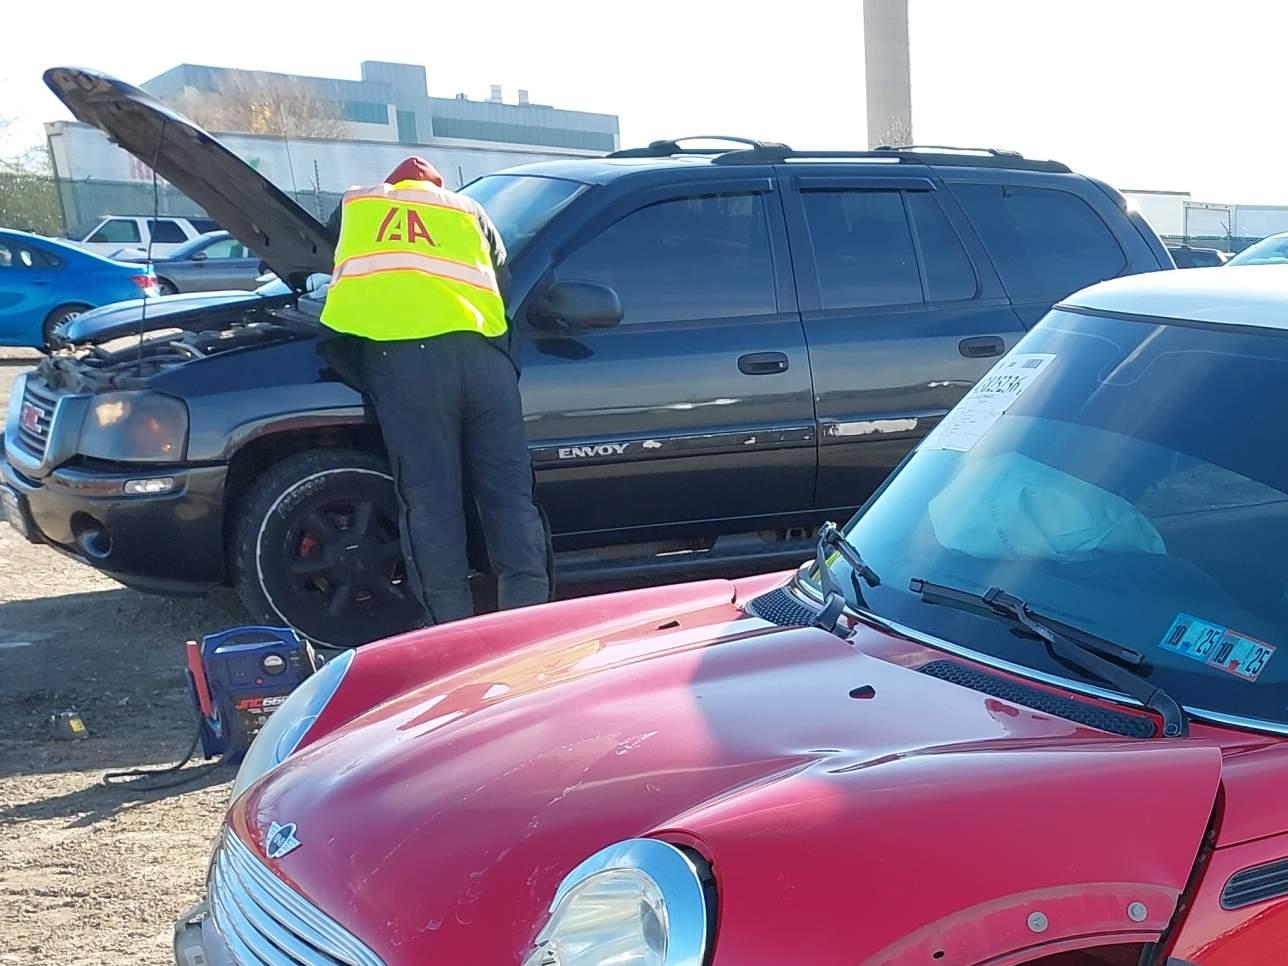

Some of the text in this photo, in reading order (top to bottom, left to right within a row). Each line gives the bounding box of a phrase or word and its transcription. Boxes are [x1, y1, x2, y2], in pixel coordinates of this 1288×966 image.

[558, 443, 629, 459] ENVOY
[1196, 629, 1220, 656] 25
[1246, 647, 1269, 675] 25
